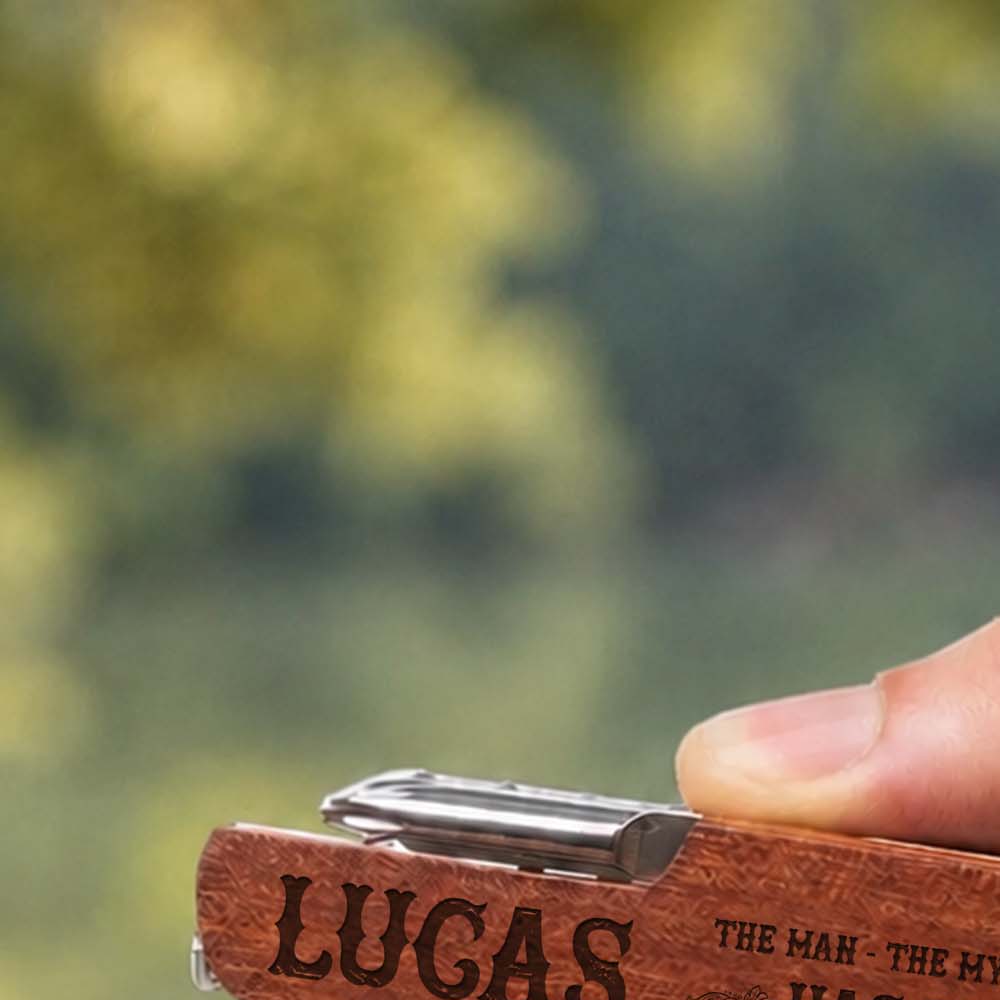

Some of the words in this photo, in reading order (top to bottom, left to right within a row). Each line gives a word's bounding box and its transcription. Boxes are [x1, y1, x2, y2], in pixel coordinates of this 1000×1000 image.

[714, 918, 777, 954] THE
[785, 928, 859, 965] MAN
[886, 941, 949, 978] THE
